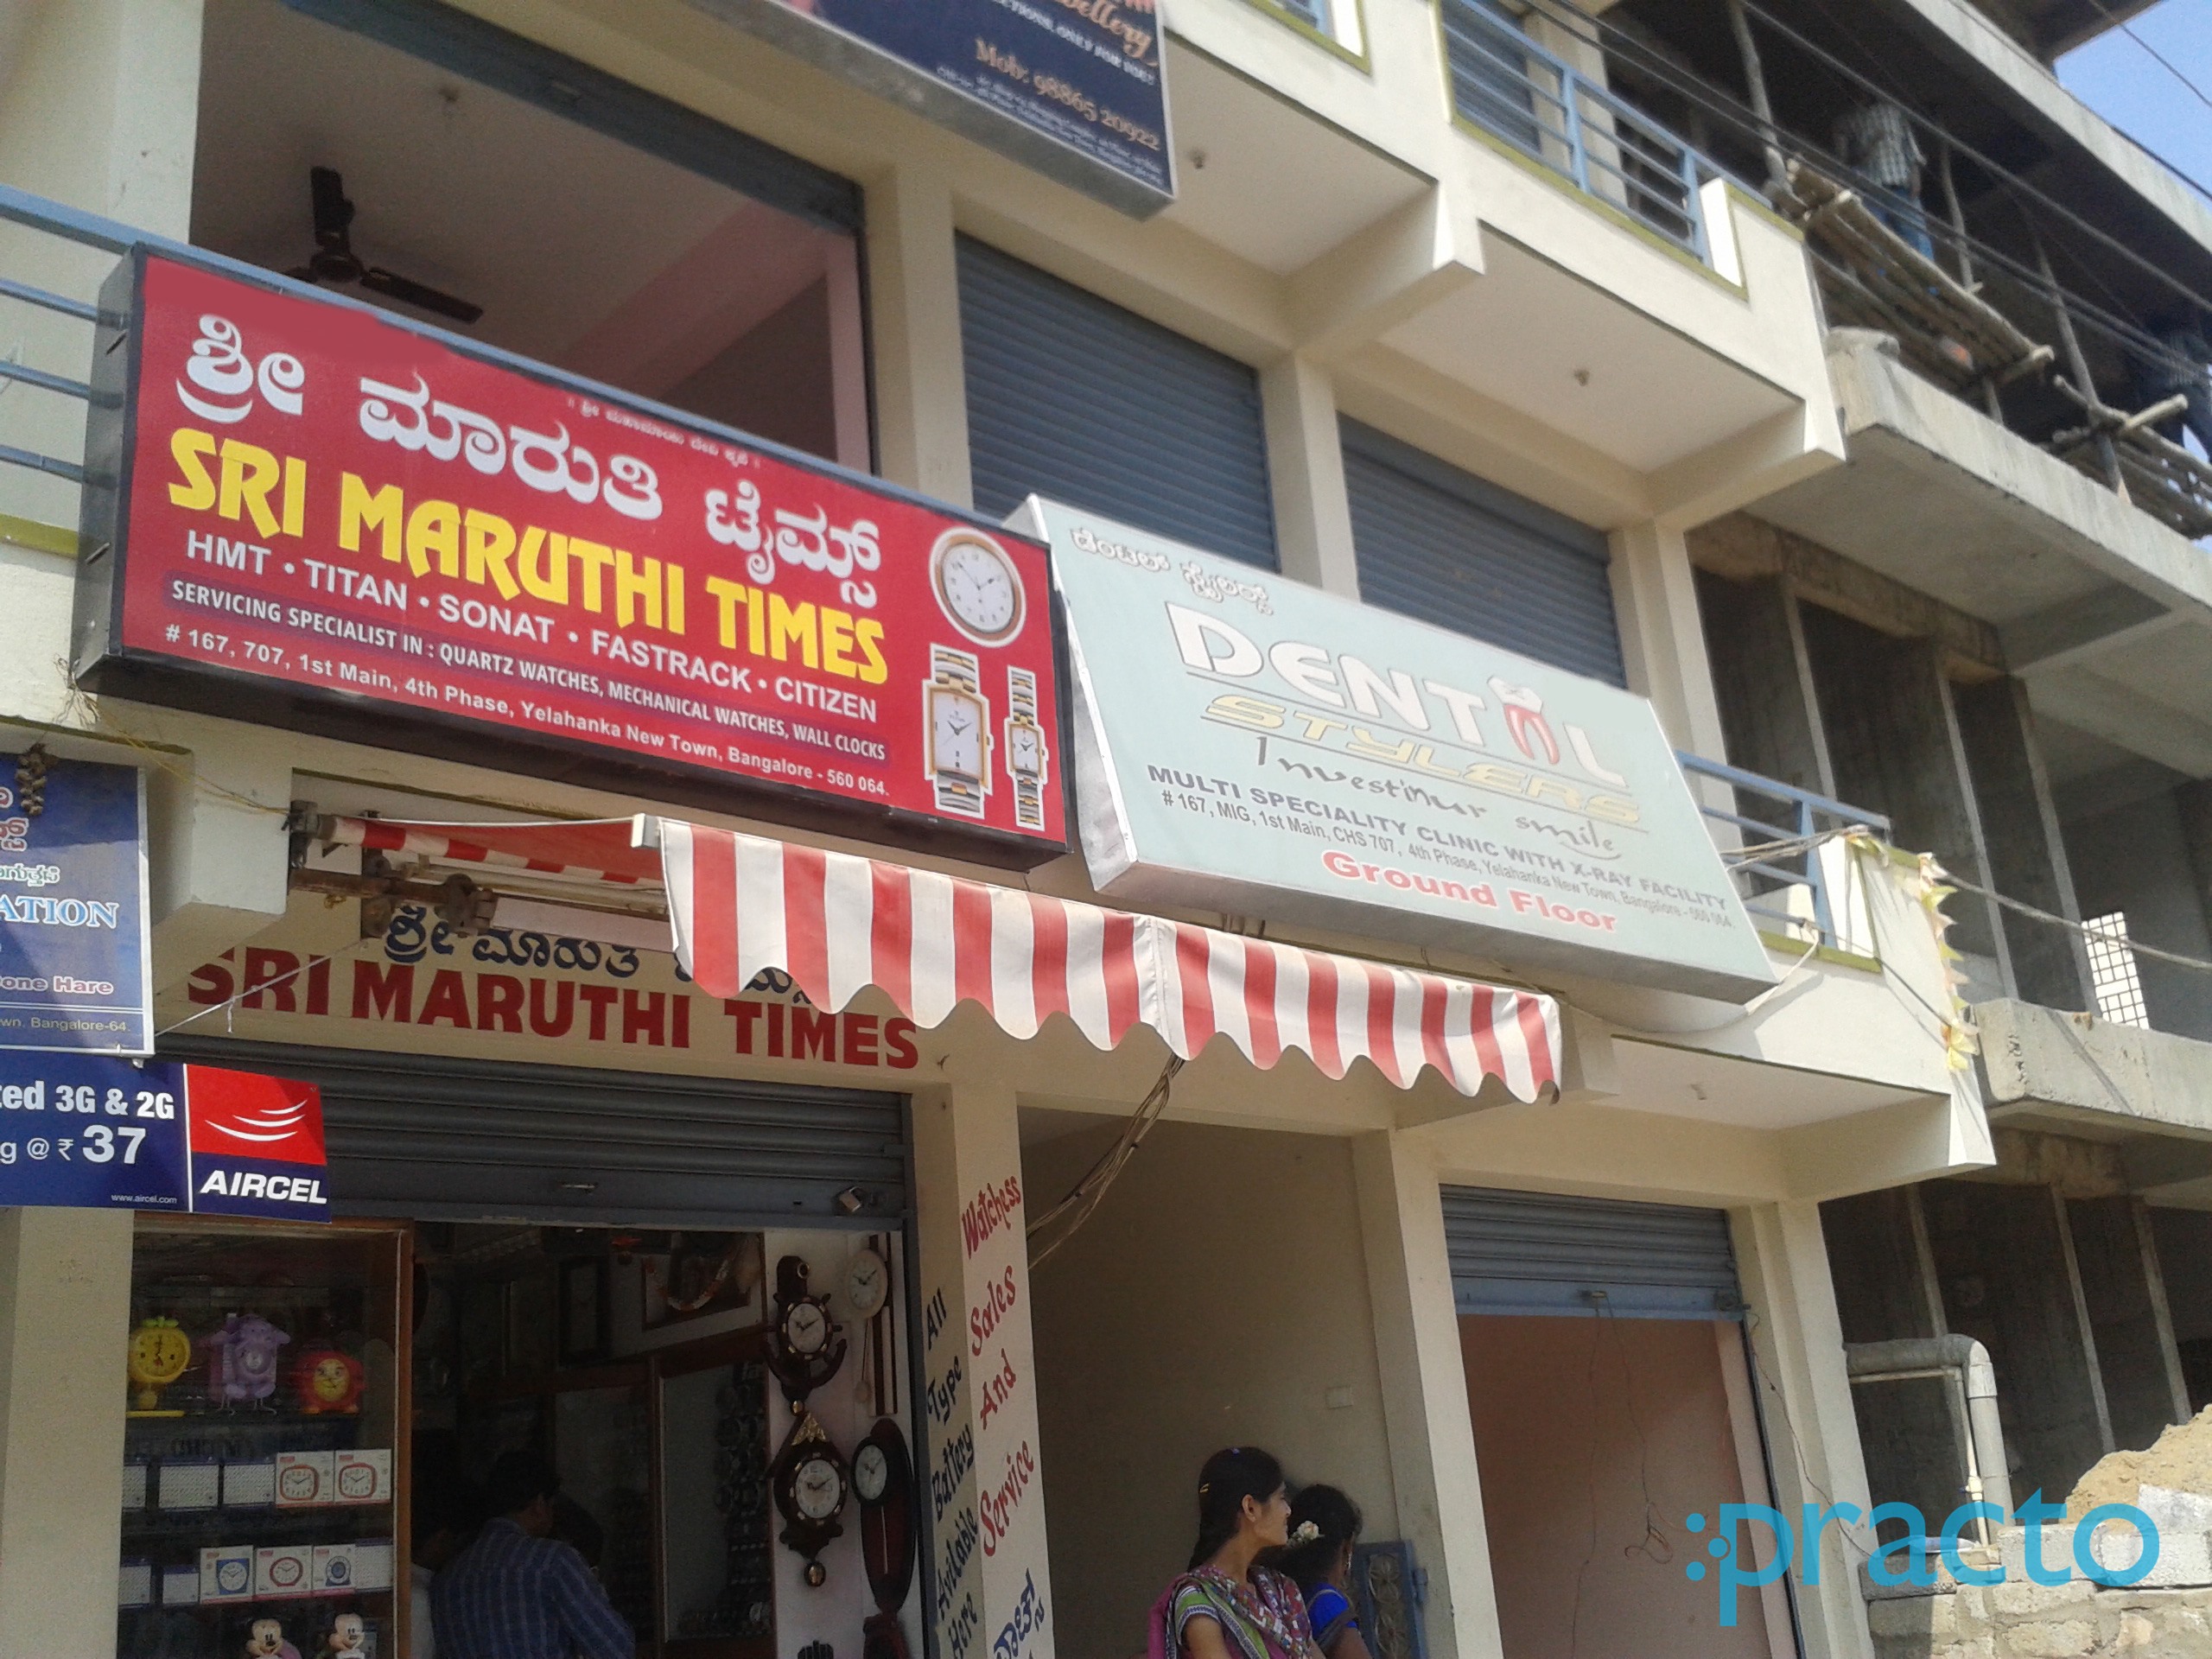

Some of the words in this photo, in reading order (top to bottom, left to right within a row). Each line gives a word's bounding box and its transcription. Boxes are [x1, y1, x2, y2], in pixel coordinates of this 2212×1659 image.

[176, 315, 304, 423] ಶ್ರೀ
[359, 368, 663, 520] ಮಾರುತಿ
[705, 478, 880, 608] ಟೈಮ್ಸ್
[168, 427, 307, 539] SRI
[338, 471, 684, 634] MARUTHI
[706, 575, 888, 684] TIMES
[172, 580, 282, 622] SERVICING
[288, 607, 397, 649] SPECIALIST
[439, 642, 514, 676] QUARTZ
[518, 659, 605, 698] WATCHES,
[607, 680, 711, 721] MECHANICAL
[714, 705, 790, 740] WATCHES,
[791, 722, 832, 748] WALL
[834, 734, 886, 760] CLOCKS
[187, 530, 271, 575] HMT
[303, 558, 408, 611] TITAN
[438, 593, 555, 644] SONAT
[591, 629, 752, 693] FASTRACK
[774, 676, 877, 723] CITIZEN
[299, 653, 333, 677] 1st
[340, 661, 398, 694] Main,
[404, 677, 438, 700] 4th
[444, 684, 515, 719] Phase,
[520, 700, 621, 739] Yelahanka
[626, 723, 665, 748] New
[671, 733, 723, 762] Town,
[728, 746, 812, 778] Bangalore
[827, 768, 854, 789] 560
[1205, 694, 1639, 824] STYLERS
[1147, 765, 1242, 799] MULTI
[1249, 787, 1406, 836] SPECIALITY
[1417, 826, 1499, 856] CLINIC
[1503, 845, 1565, 872] WITH
[1569, 861, 1631, 887] X-RAY
[1639, 878, 1726, 911] FACILITY
[1259, 810, 1285, 830] 1st
[1287, 816, 1332, 842] Main,
[1332, 827, 1367, 848] CHS
[1408, 843, 1432, 861] 4th
[1482, 859, 1551, 887] Yelahanka
[1552, 875, 1580, 894] New
[1515, 816, 1622, 854] smile
[1323, 851, 1499, 909] Ground
[1508, 887, 1618, 931] Floor
[54, 976, 114, 995] Hare
[188, 945, 332, 1017] SRI
[351, 959, 690, 1049] MARUTHI
[724, 999, 918, 1070] TIMES
[27, 1137, 50, 1160] @
[82, 1124, 146, 1165] 37
[55, 1085, 96, 1113] 3G
[105, 1088, 129, 1116] &
[136, 1091, 175, 1119] 2G
[111, 1193, 178, 1205] www.aircel.com
[200, 1170, 327, 1205] AIRCEL
[926, 1287, 947, 1351] All
[971, 1265, 1016, 1357] Sales
[927, 1355, 962, 1427] Type
[980, 1348, 1017, 1431] And
[931, 1423, 975, 1523] Battery
[980, 1440, 1034, 1557] Service
